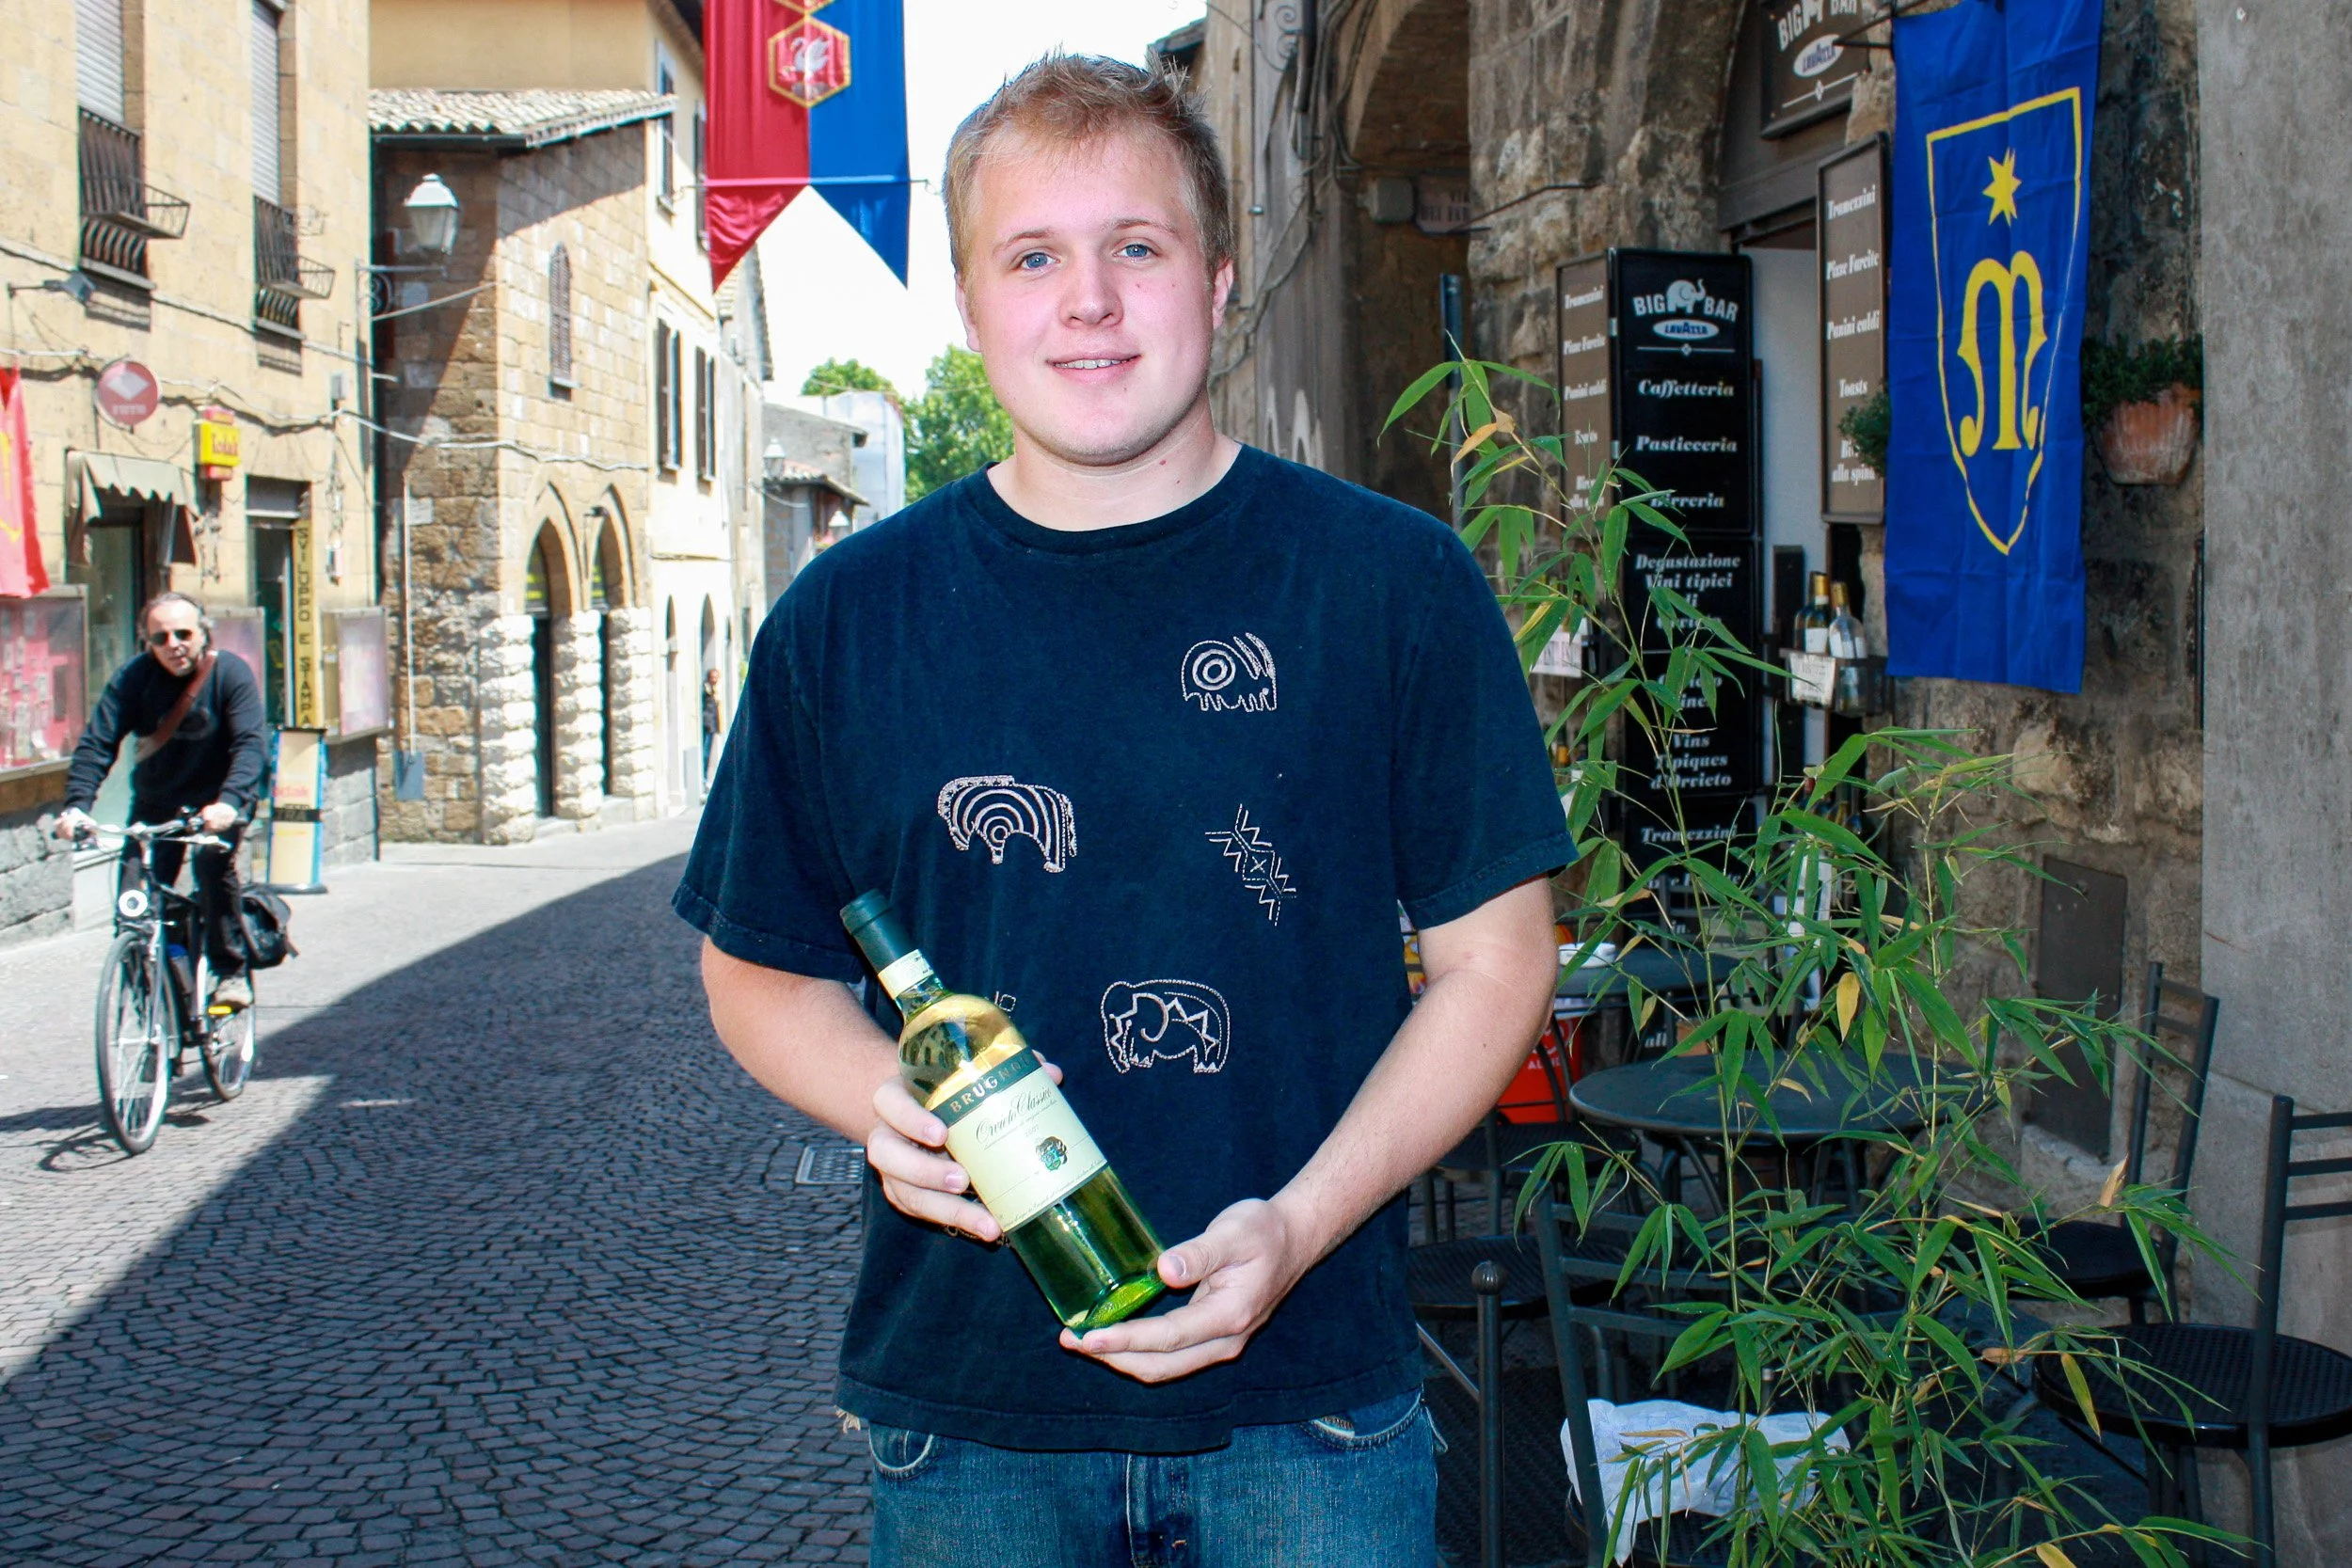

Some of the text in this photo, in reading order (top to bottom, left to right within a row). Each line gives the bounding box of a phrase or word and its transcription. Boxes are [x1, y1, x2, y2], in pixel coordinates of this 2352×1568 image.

[1778, 3, 1803, 52] BIG
[1632, 293, 1739, 323] BIG BAR
[1638, 378, 1735, 398] Caffetteria
[1636, 435, 1738, 452] Pasticceria
[1635, 552, 1741, 572] Degustazione
[1686, 573, 1733, 592] tipici
